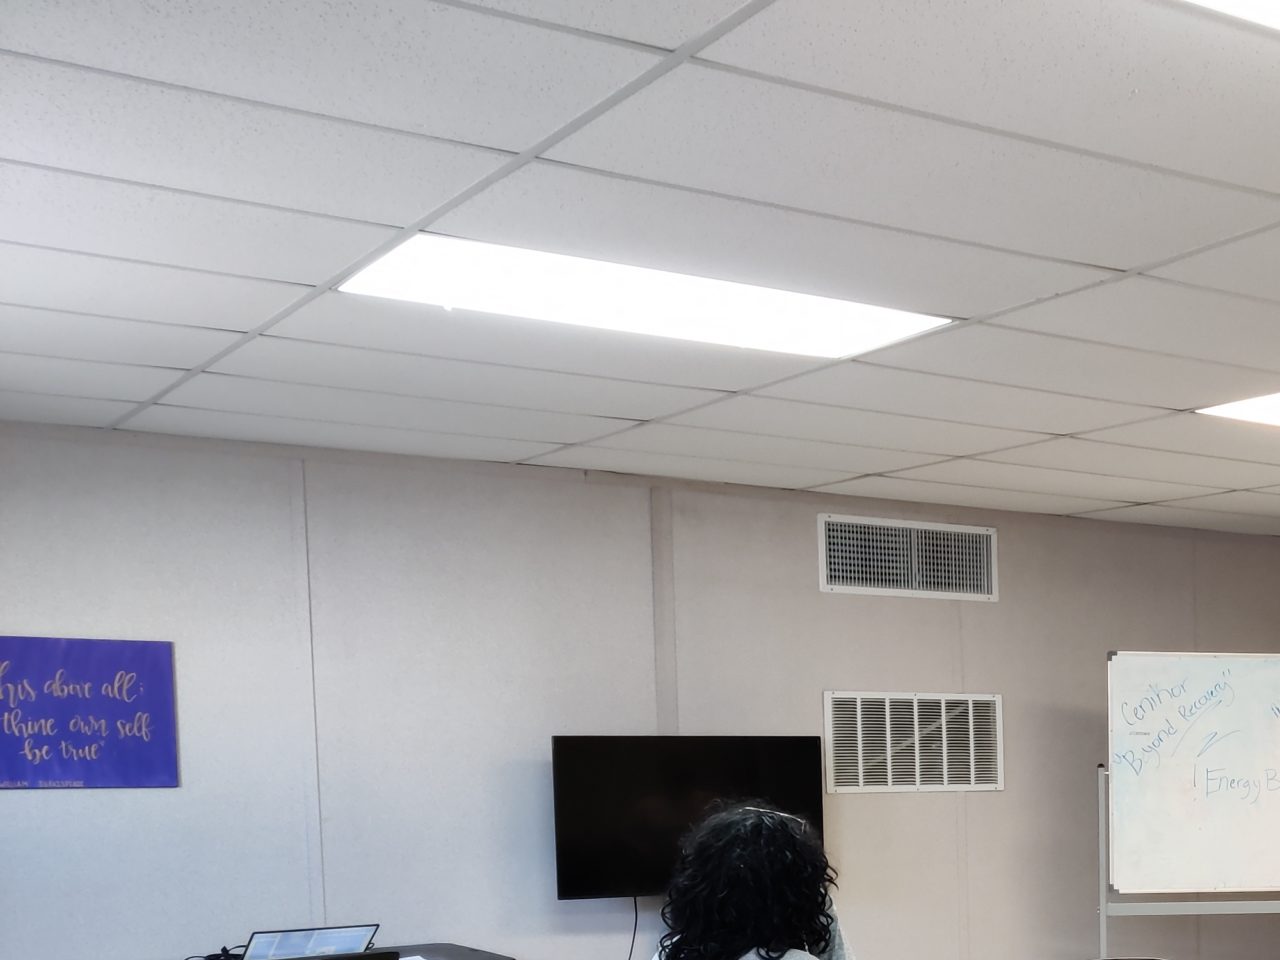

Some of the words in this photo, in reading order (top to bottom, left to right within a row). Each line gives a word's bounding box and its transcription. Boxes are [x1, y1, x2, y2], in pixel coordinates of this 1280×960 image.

[0, 660, 37, 708] his
[43, 669, 93, 699] above
[0, 708, 57, 738] thine
[69, 714, 109, 738] own
[116, 711, 154, 742] self
[19, 738, 51, 765] be
[1206, 767, 1260, 805] Energy
